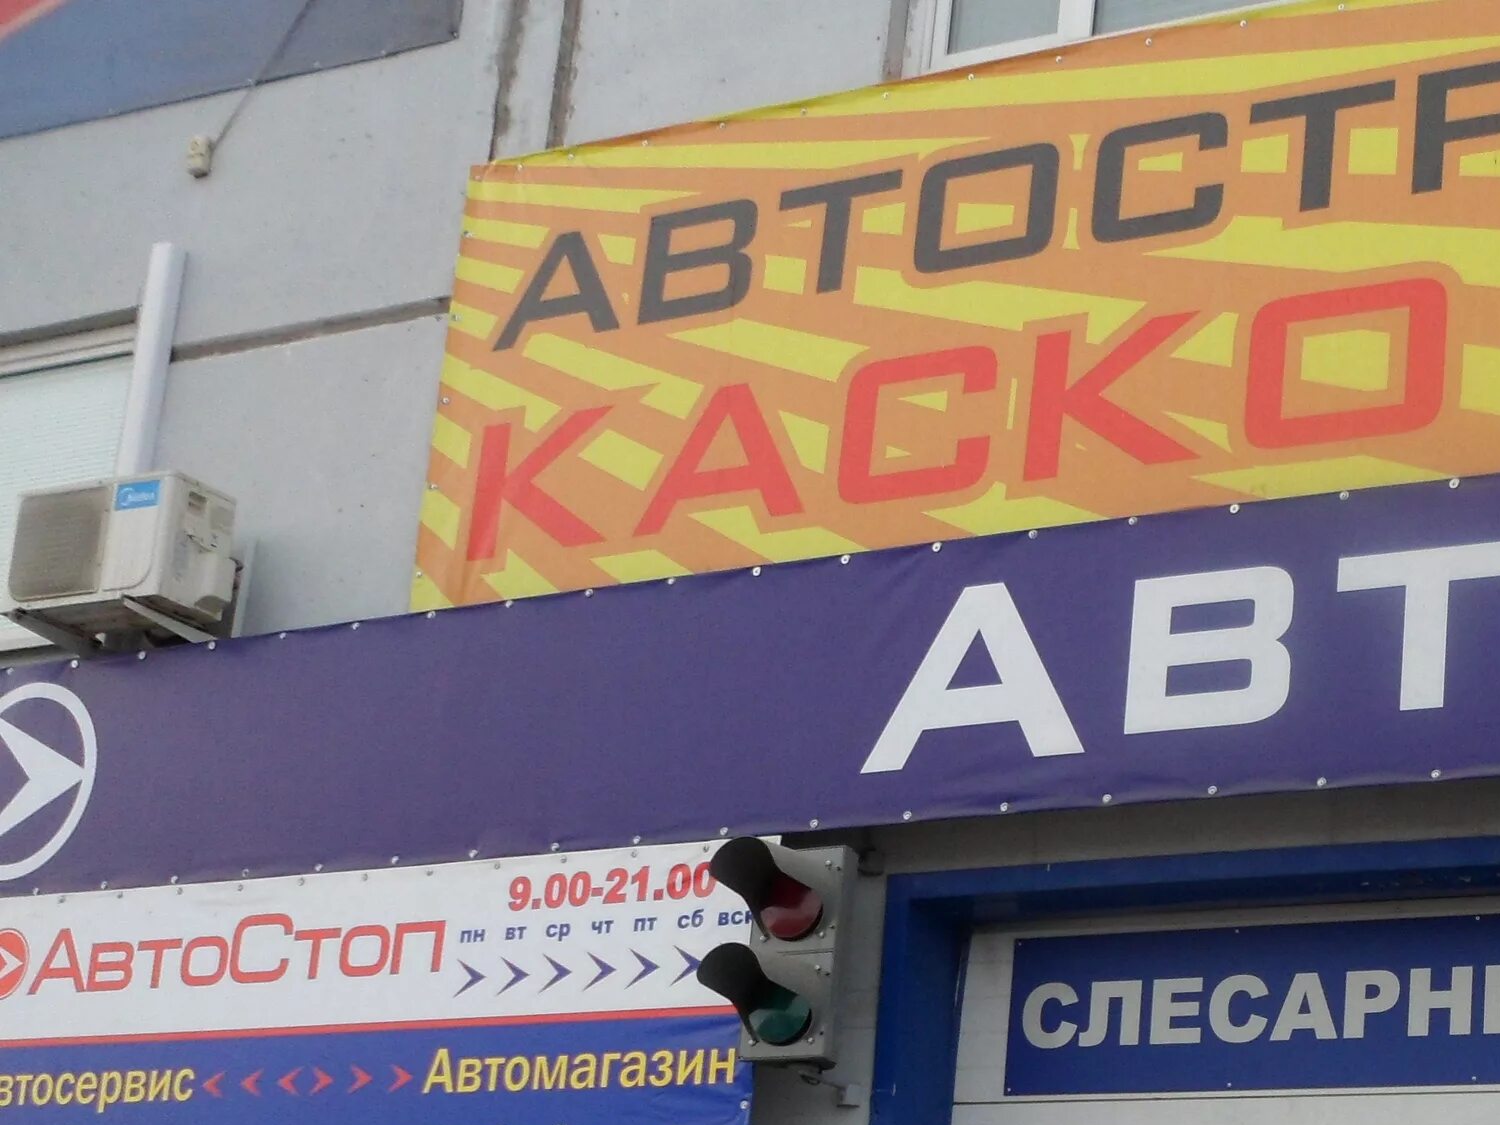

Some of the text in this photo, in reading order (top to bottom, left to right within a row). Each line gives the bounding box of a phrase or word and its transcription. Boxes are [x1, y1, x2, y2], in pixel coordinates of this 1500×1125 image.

[465, 277, 1448, 562] КАСКО
[507, 860, 717, 911] 9.00-21.00
[459, 927, 486, 944] пн
[505, 924, 527, 941] вт
[545, 921, 571, 942] ср
[591, 920, 614, 936] чт
[633, 915, 657, 933] пт
[677, 908, 705, 929] сб
[422, 1047, 736, 1095] Автомагазин
